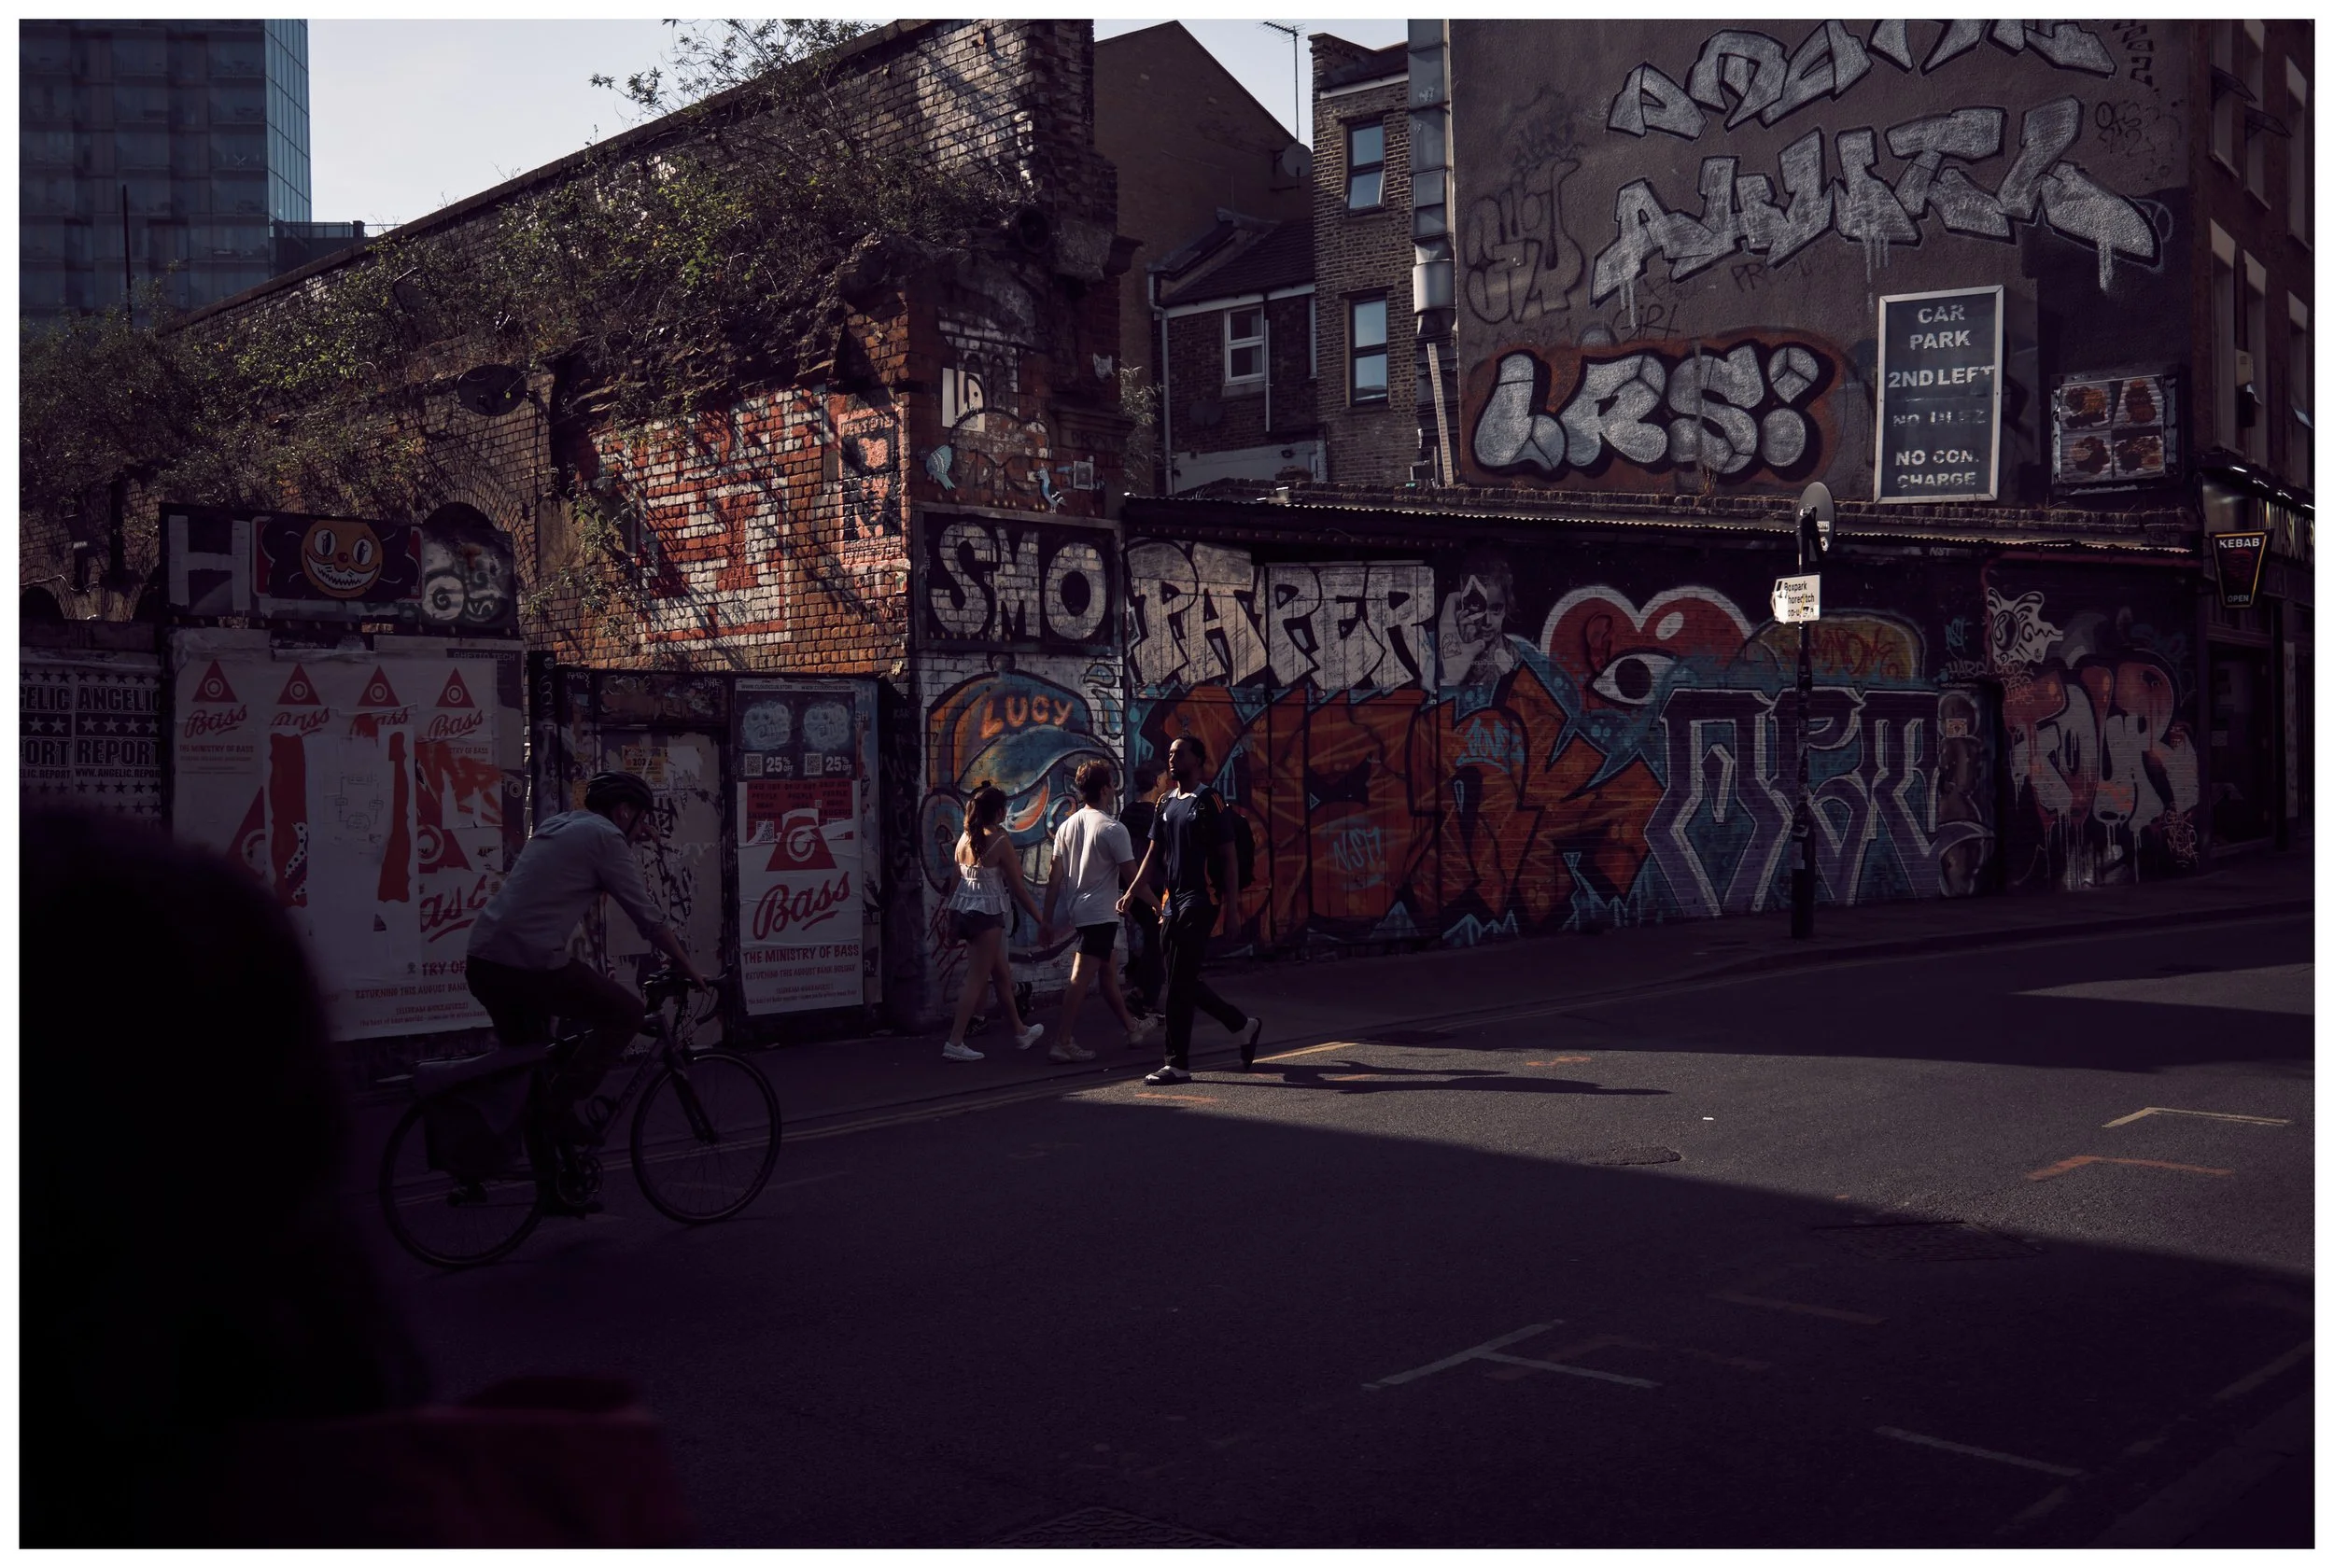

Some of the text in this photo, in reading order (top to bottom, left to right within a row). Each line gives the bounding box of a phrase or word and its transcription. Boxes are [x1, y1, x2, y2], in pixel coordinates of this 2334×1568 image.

[1918, 305, 1965, 324] CAR
[1909, 329, 1971, 350] PARK
[1888, 365, 1994, 388] 2ND LEFT
[1895, 450, 1926, 466] NO
[1897, 471, 1976, 488] CHARGE
[2219, 538, 2260, 549] KEBAB
[929, 521, 1108, 642] SMO
[2227, 595, 2249, 603] OPEN
[185, 705, 247, 738] Bass
[429, 710, 483, 742] Bass
[979, 694, 1073, 739] LUCY
[752, 872, 851, 940] Bass
[744, 945, 859, 964] THE MINISTRY OF BASS
